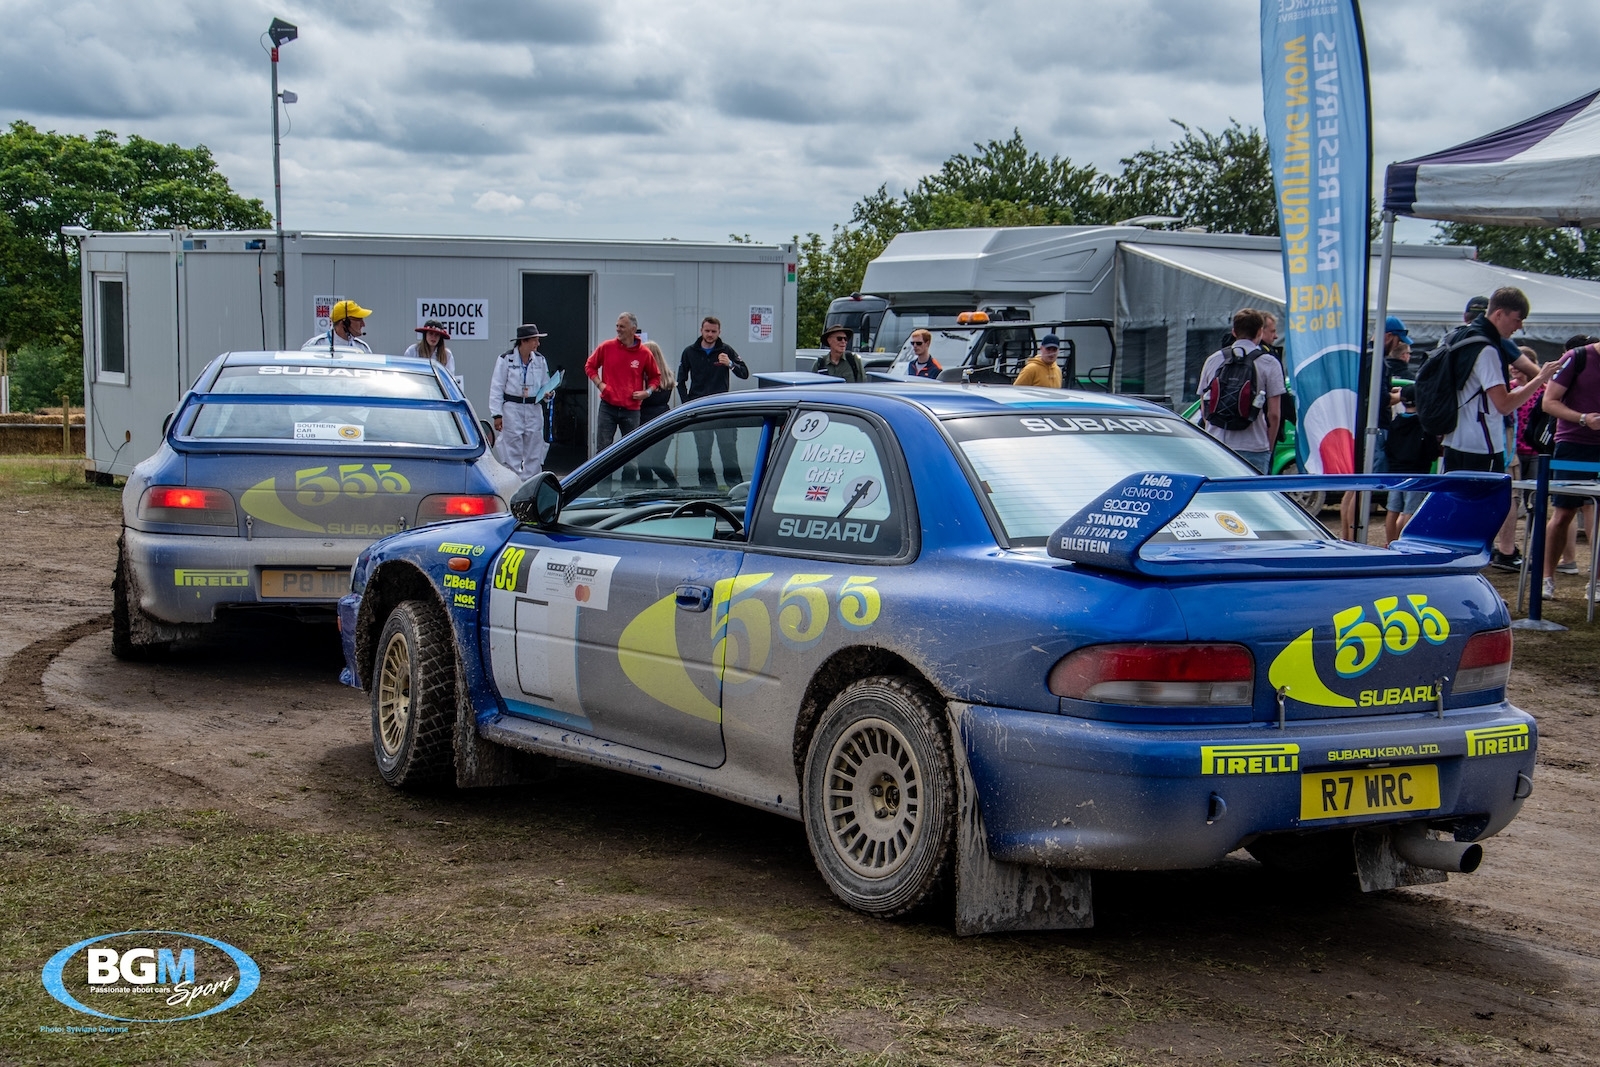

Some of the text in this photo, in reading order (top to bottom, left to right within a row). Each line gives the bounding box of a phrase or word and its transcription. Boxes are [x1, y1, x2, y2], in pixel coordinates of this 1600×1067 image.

[422, 303, 484, 318] PADDOCK
[800, 419, 820, 433] 39
[1020, 418, 1173, 433] SUBARU
[801, 444, 865, 464] McRae
[805, 466, 844, 484] Grist
[1140, 474, 1173, 488] Hella
[295, 463, 412, 507] 555
[1121, 486, 1174, 501] KENWOOD
[1102, 498, 1151, 515] sparco
[1086, 513, 1141, 529] STANDOX
[1177, 511, 1210, 520] THERN
[327, 523, 411, 535] SUBAR
[777, 518, 880, 543] SUBARU
[1073, 526, 1129, 540] IHI TURBO
[1169, 521, 1190, 529] CAR
[1175, 530, 1202, 538] CLUB
[437, 542, 474, 556] PIRELLI
[1060, 536, 1111, 554] BILSTEIN
[174, 568, 249, 587] PIRELLI
[494, 546, 525, 592] 39
[283, 573, 351, 593] P8 WR
[451, 575, 477, 591] Beta
[454, 593, 476, 605] NGK
[710, 572, 882, 697] 555
[1332, 593, 1452, 679] 555
[1358, 685, 1440, 708] SUBARU
[1465, 724, 1529, 757] PIRELLI
[1201, 743, 1300, 775] PIRELLI
[1327, 748, 1377, 762] SUBARU
[1418, 743, 1440, 755] LTD.
[1321, 772, 1414, 812] R7 WRC
